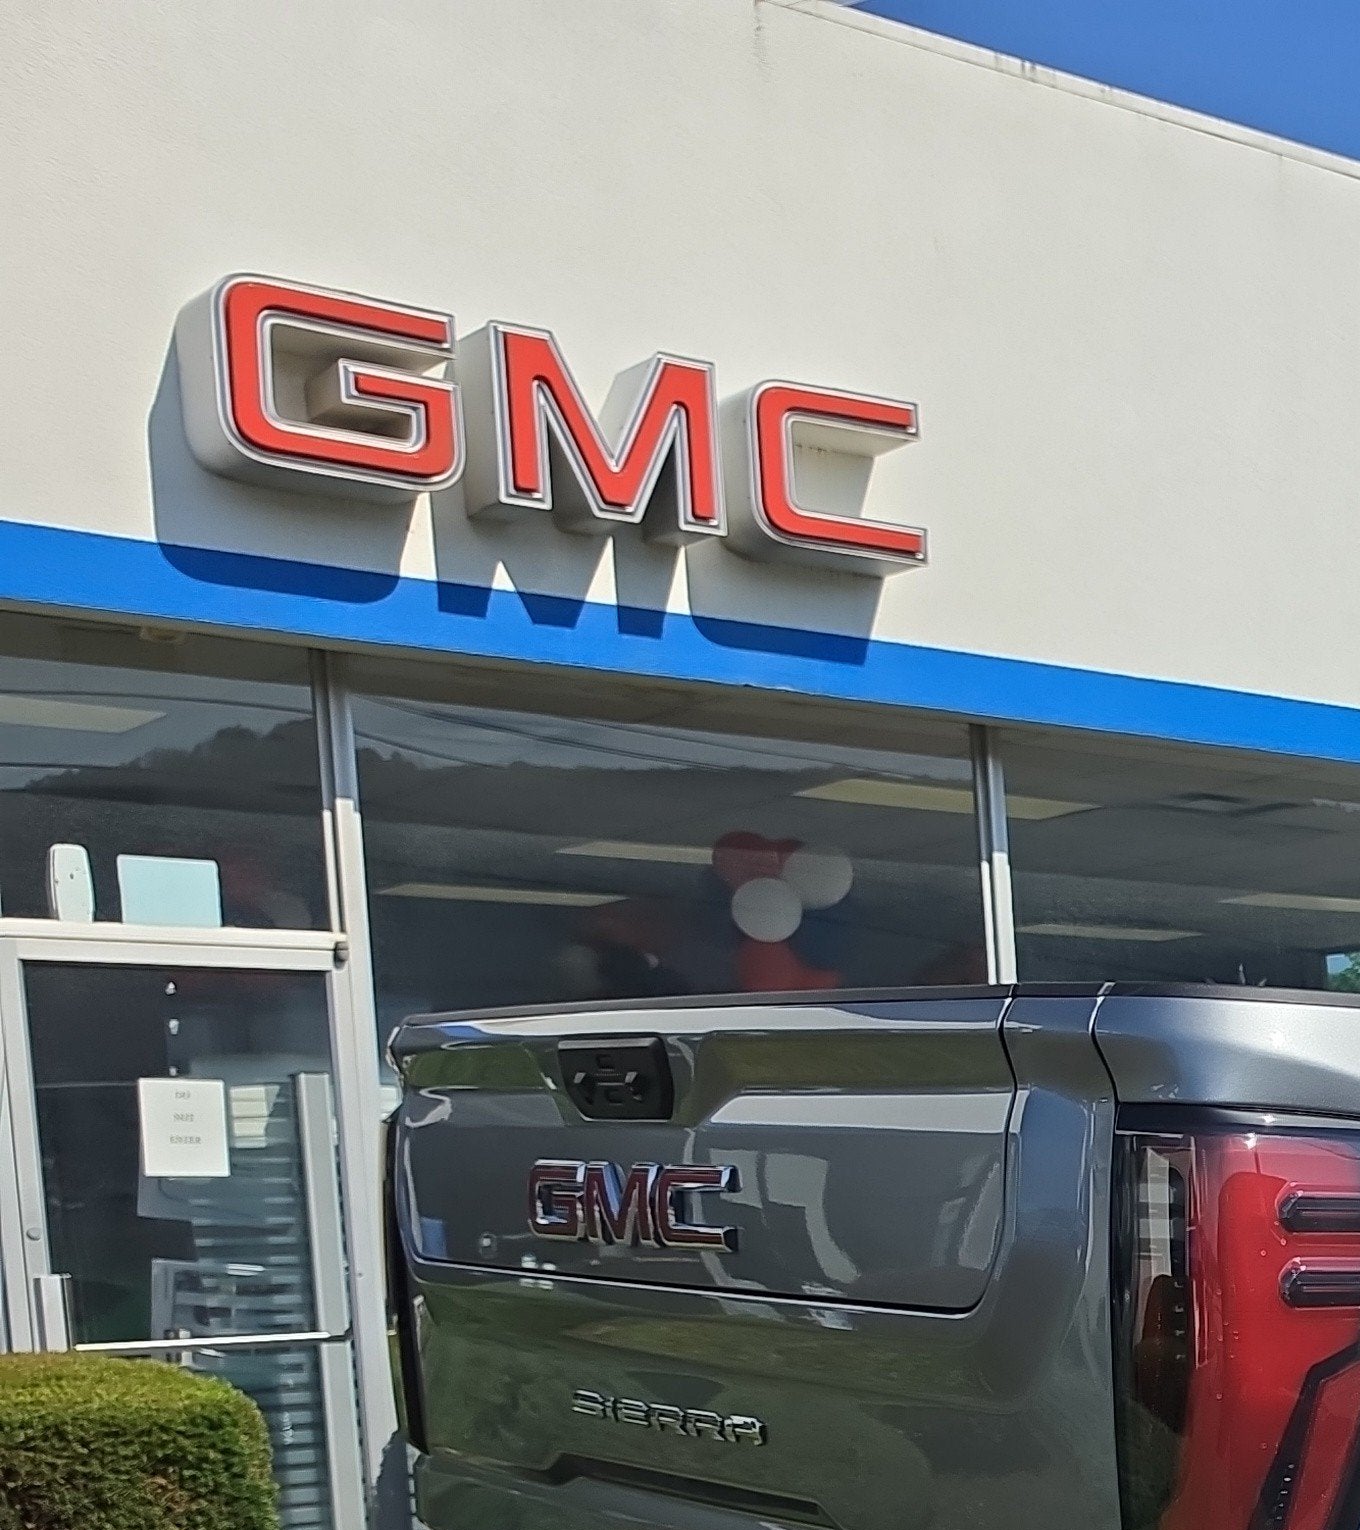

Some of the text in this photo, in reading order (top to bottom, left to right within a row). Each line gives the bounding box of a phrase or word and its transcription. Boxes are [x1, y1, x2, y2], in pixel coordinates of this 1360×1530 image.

[206, 272, 929, 566] GMC
[528, 1159, 742, 1253] GMC
[572, 1389, 767, 1446] SIERRA
